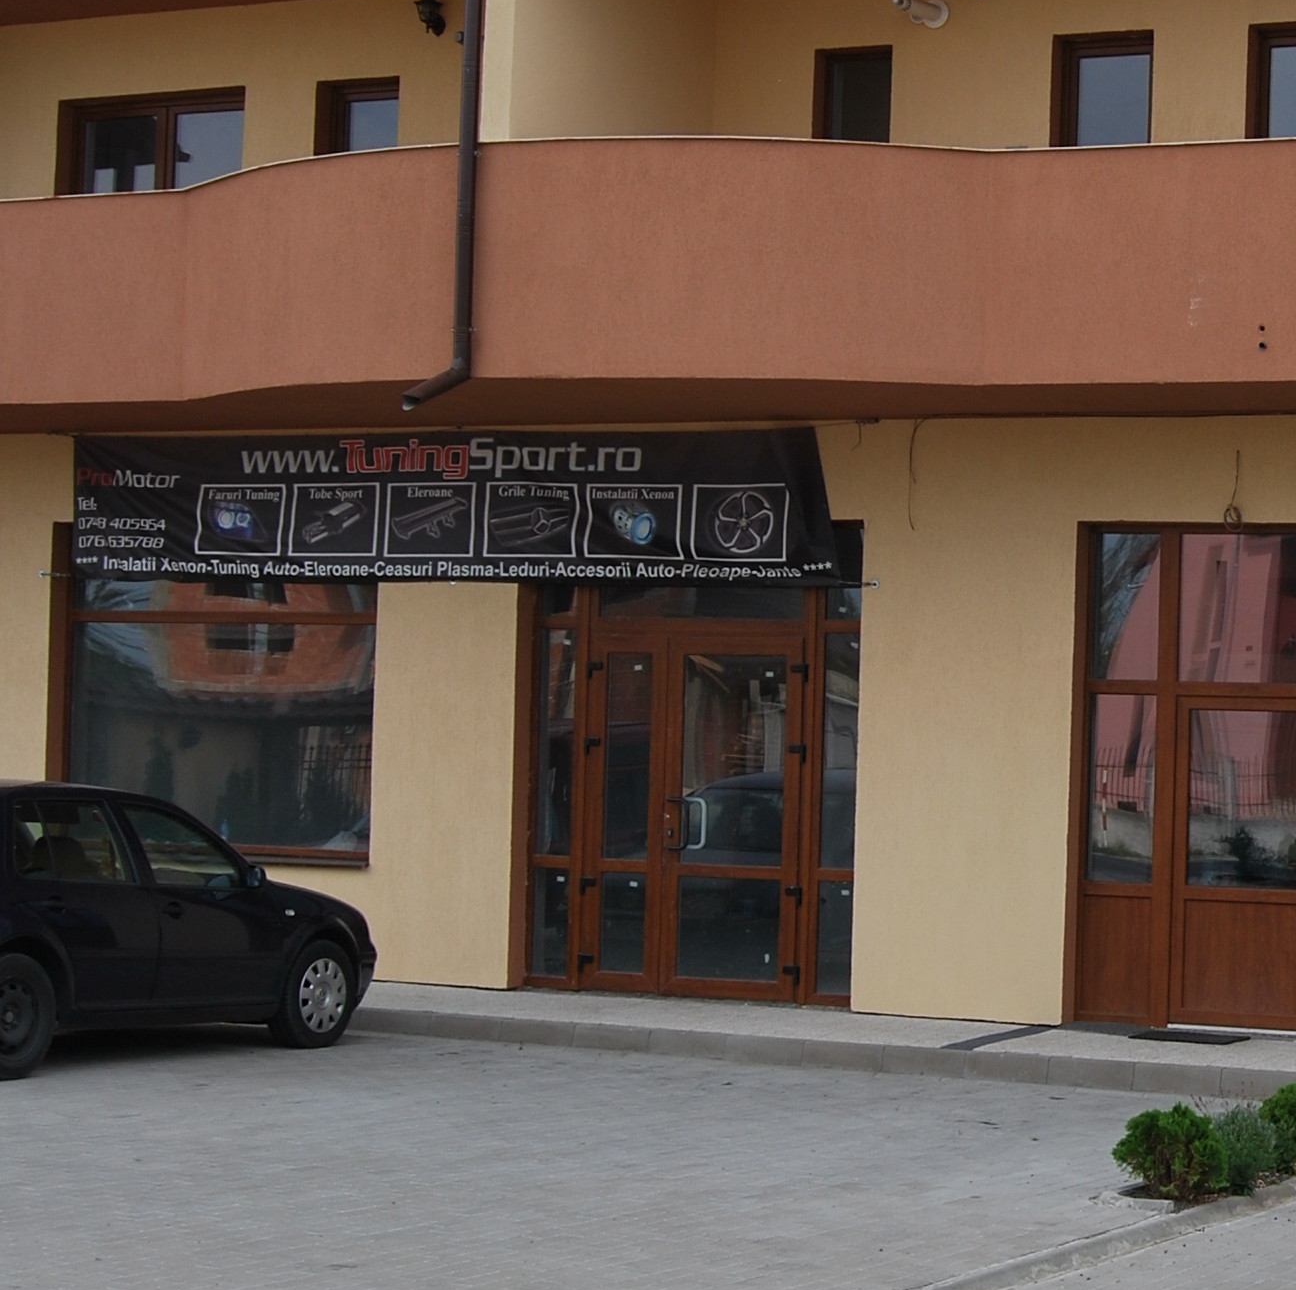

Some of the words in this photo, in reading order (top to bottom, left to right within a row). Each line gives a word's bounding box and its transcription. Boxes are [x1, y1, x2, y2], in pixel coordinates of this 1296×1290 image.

[241, 437, 642, 479] www.TuningSport.ro
[77, 467, 180, 488] ProMotor
[208, 489, 242, 501] Faruri
[246, 489, 280, 503] Tuning
[308, 488, 333, 500] Tobe
[335, 488, 363, 502] Sport
[406, 487, 454, 498] Eleroane
[498, 486, 528, 498] Grile
[530, 486, 569, 501] Tuning
[591, 489, 638, 500] Instalatii
[640, 489, 675, 500] Xenon
